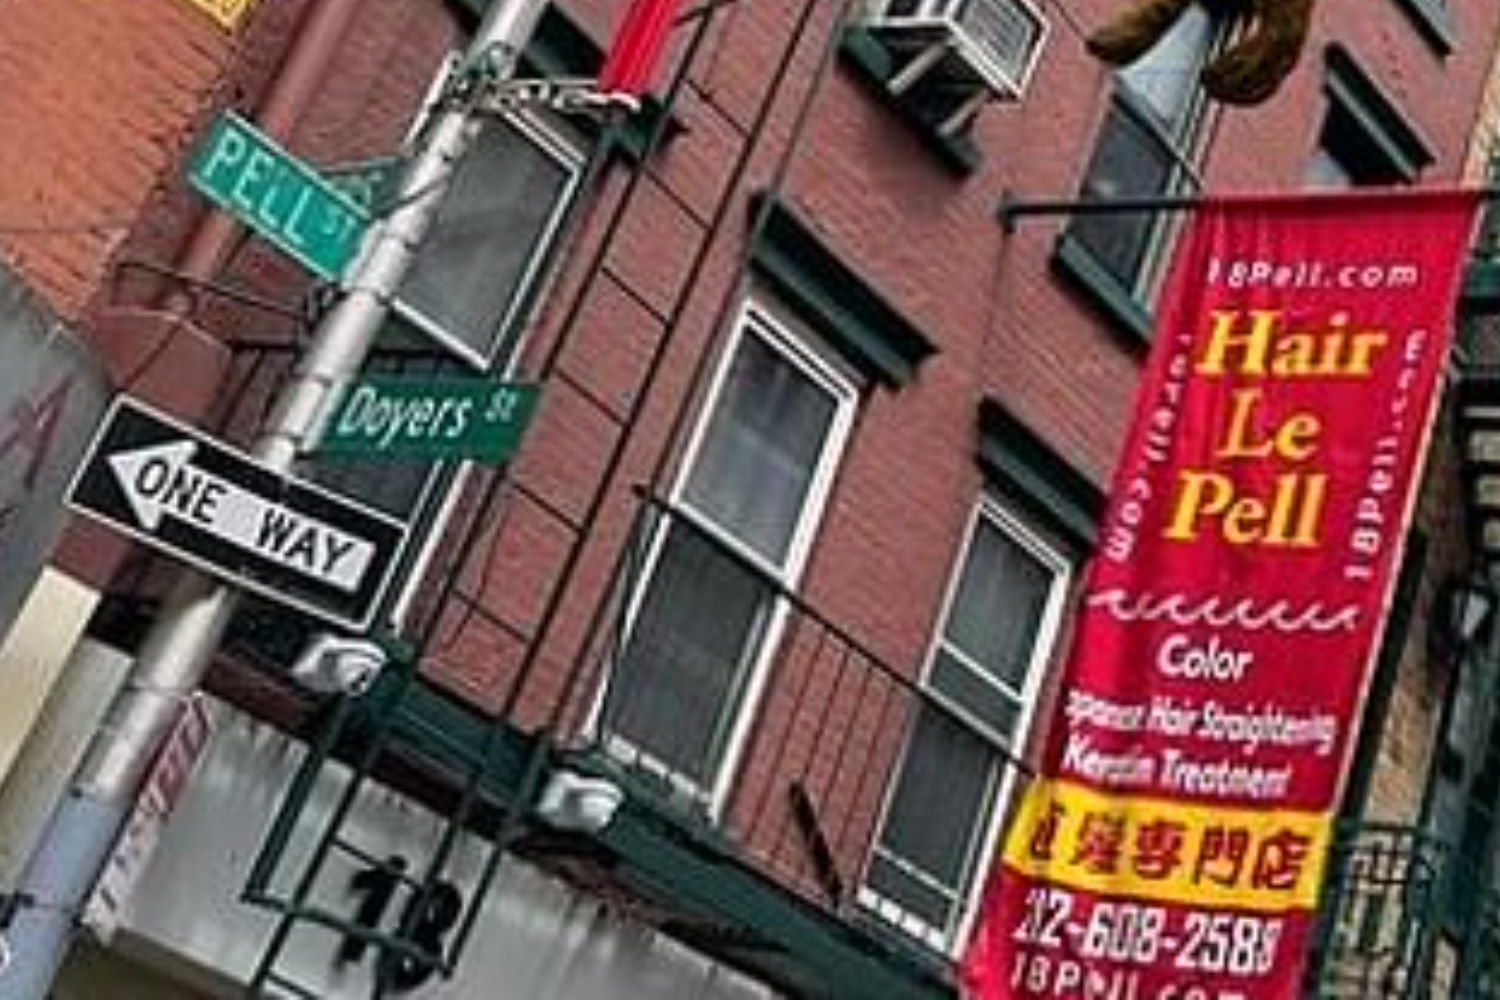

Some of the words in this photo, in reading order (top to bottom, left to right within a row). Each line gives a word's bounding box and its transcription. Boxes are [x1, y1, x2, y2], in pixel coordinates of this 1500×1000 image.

[202, 126, 306, 246] PELL
[322, 204, 359, 245] ST
[1207, 256, 1420, 289] 18Pell.com
[1193, 307, 1389, 377] Hair
[336, 384, 473, 450] Doyers
[484, 387, 520, 422] St
[1213, 386, 1322, 461] Le
[135, 458, 228, 525] ONE
[256, 508, 357, 573] WAY
[1161, 467, 1330, 549] Pell
[1155, 633, 1255, 682] Color
[1147, 696, 1197, 739] Hair
[1159, 749, 1292, 800] Treatment
